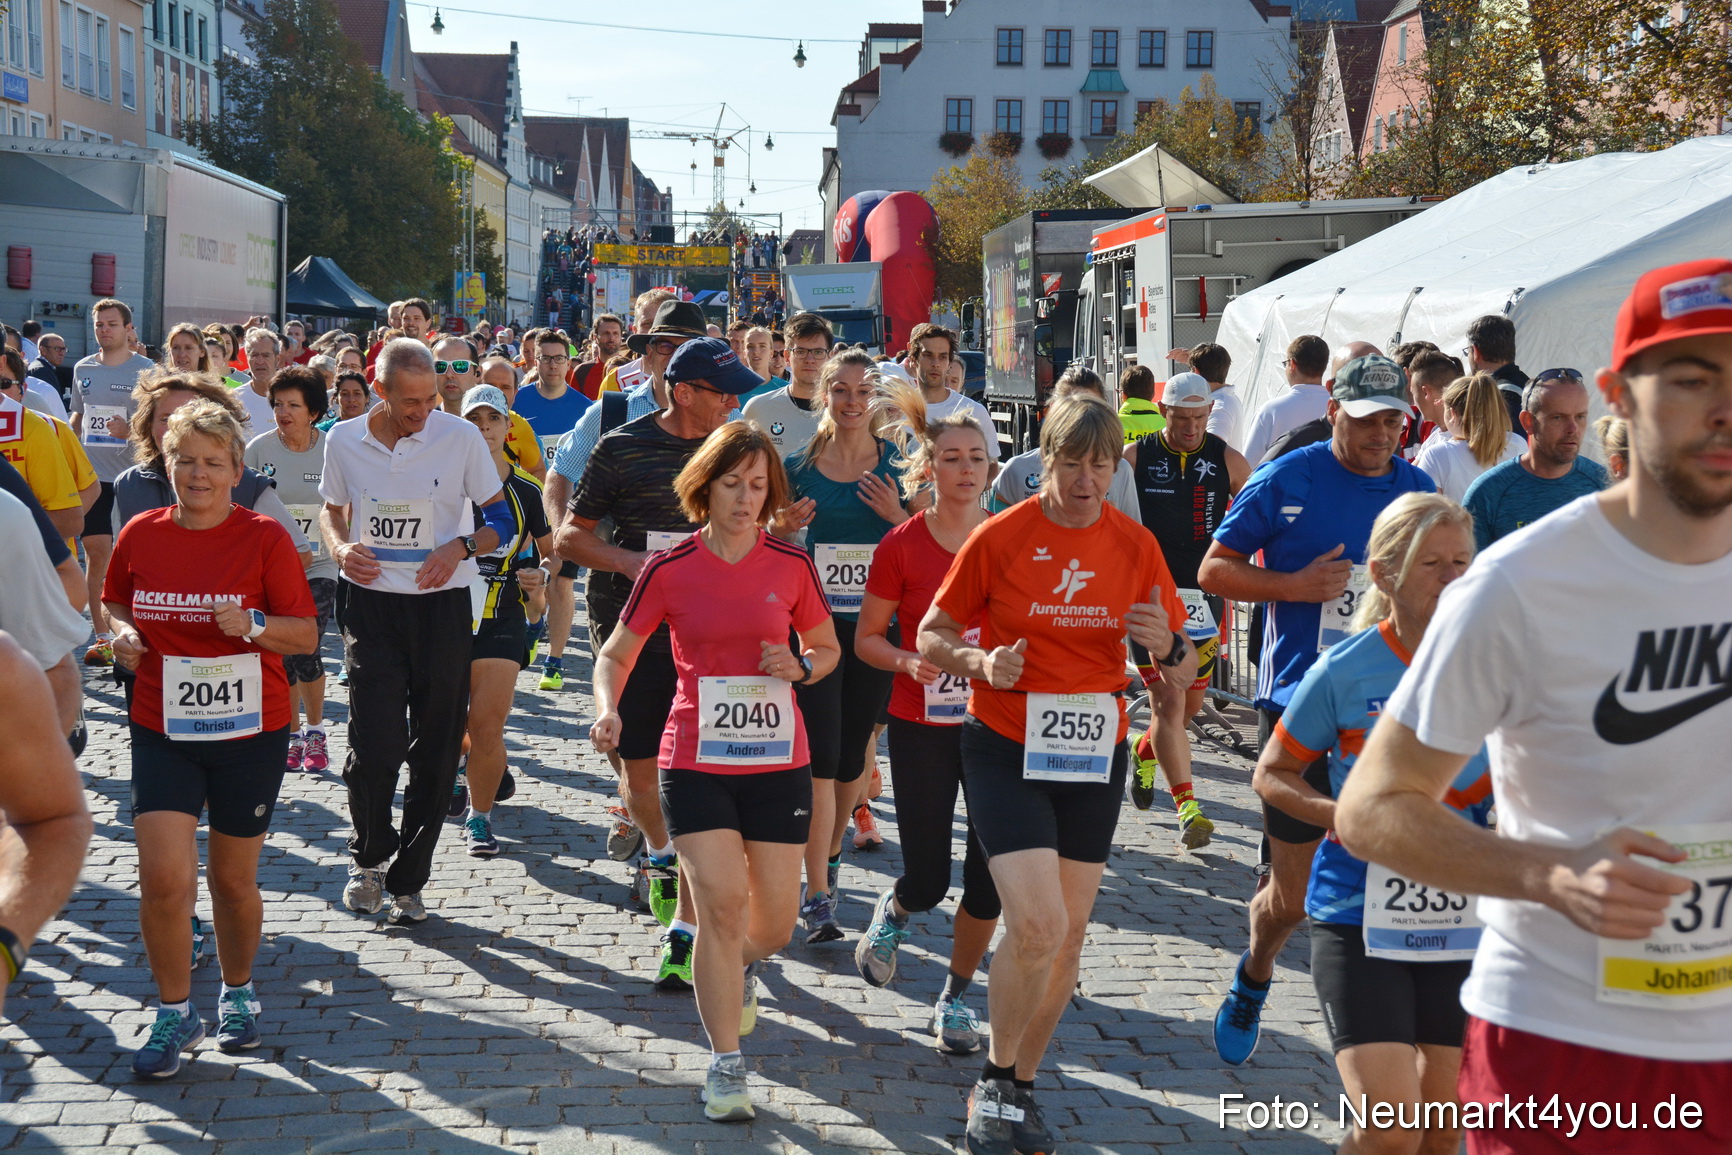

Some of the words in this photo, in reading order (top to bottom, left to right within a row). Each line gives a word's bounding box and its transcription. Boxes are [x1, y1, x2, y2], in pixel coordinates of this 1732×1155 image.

[246, 232, 277, 290] BOCK
[638, 249, 686, 261] START
[812, 286, 855, 296] BOCK
[1362, 371, 1398, 384] KINGS
[1194, 486, 1205, 509] ROTH
[378, 504, 410, 512] BOCK
[1206, 491, 1216, 534] TRIATHLON
[370, 516, 422, 539] 3077
[1194, 525, 1205, 541] TSG
[826, 564, 871, 585] 203
[1028, 602, 1108, 616] funrunners
[180, 613, 211, 623] KÜCHE
[1053, 616, 1119, 629] neumarkt
[1623, 622, 1732, 693] NIK
[191, 664, 234, 675] BOCK
[178, 679, 244, 707] 2041
[727, 685, 767, 694] BOCK
[1057, 694, 1097, 705] BOCK
[207, 708, 236, 716] Neumarkt
[714, 703, 780, 729] 2040
[194, 720, 236, 732] Christa
[1041, 710, 1106, 741] 2553
[726, 744, 766, 756] Andrea
[1046, 743, 1068, 751] PARTL
[1047, 756, 1093, 773] Hildegard
[1391, 917, 1417, 925] PARTL
[1404, 933, 1448, 950] Conny
[1645, 943, 1686, 954] PARTL
